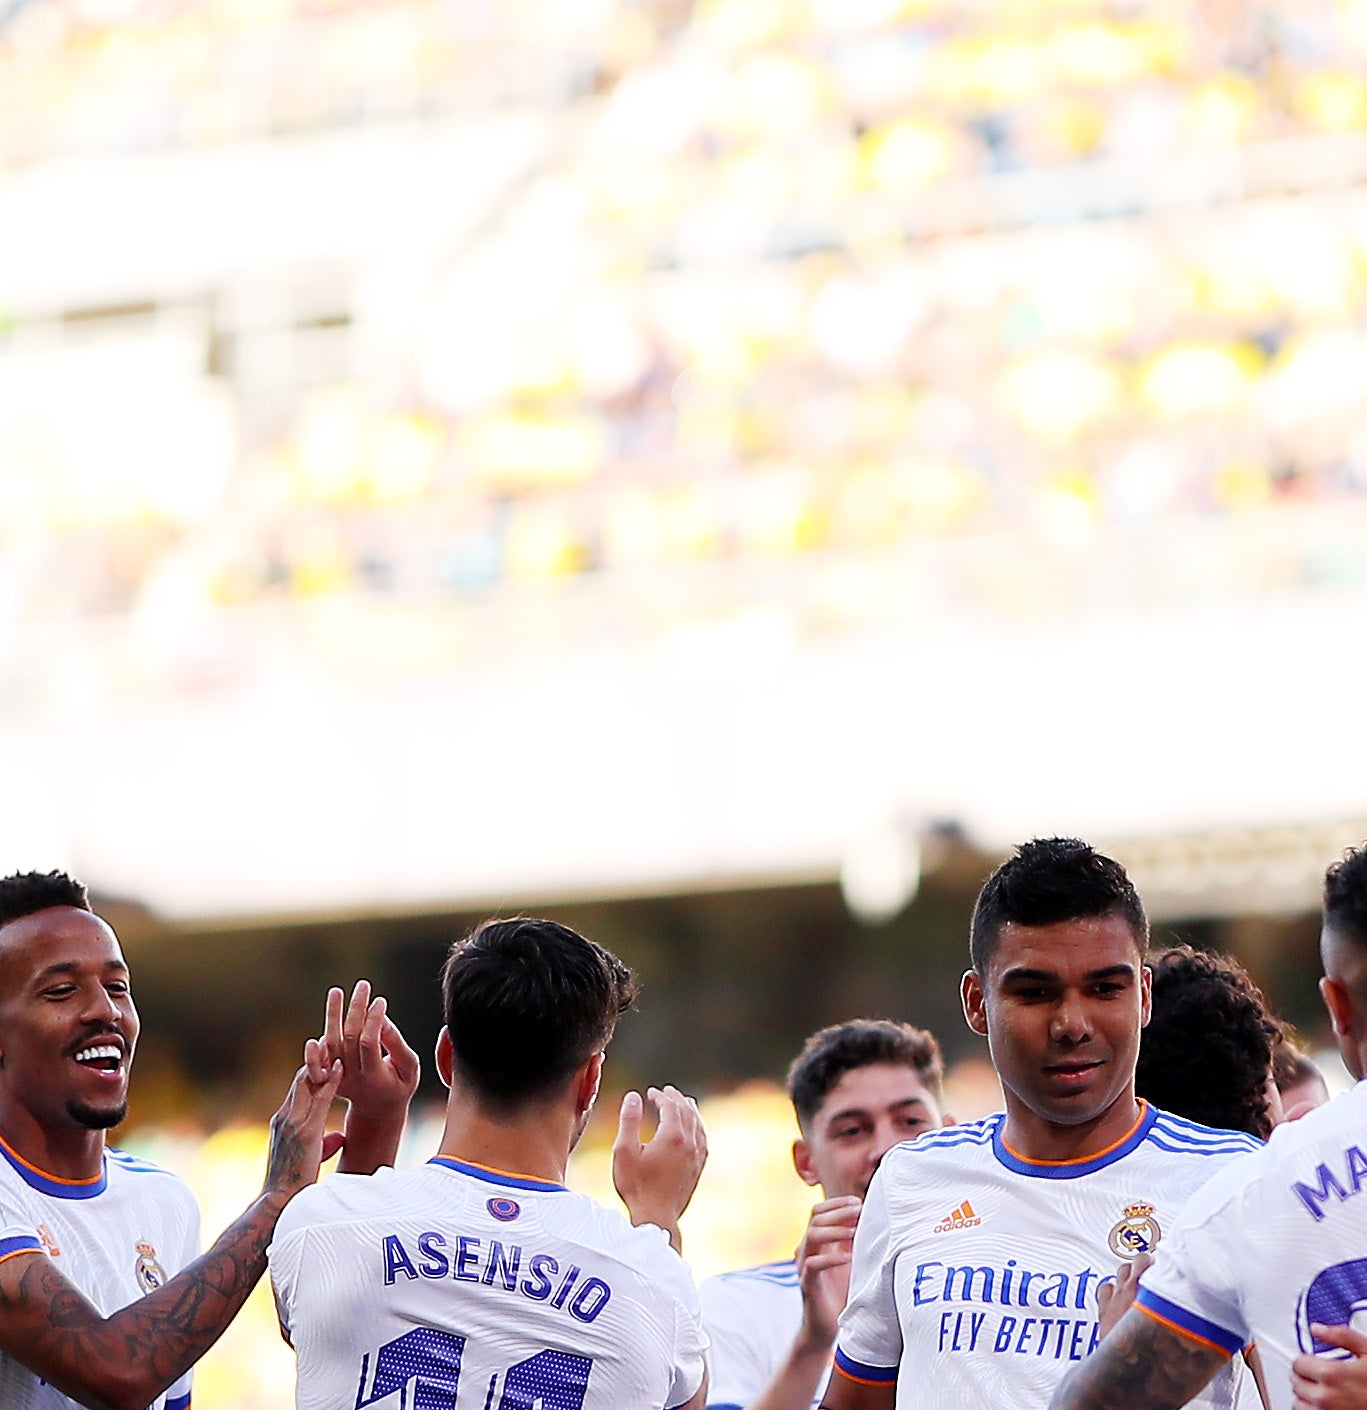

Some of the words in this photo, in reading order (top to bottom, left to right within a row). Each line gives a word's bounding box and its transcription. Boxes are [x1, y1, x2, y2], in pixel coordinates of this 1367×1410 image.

[933, 1216, 982, 1234] adidas
[382, 1231, 612, 1324] ASENSIO
[912, 1259, 1118, 1310] Emirat
[938, 1311, 986, 1353] FLY
